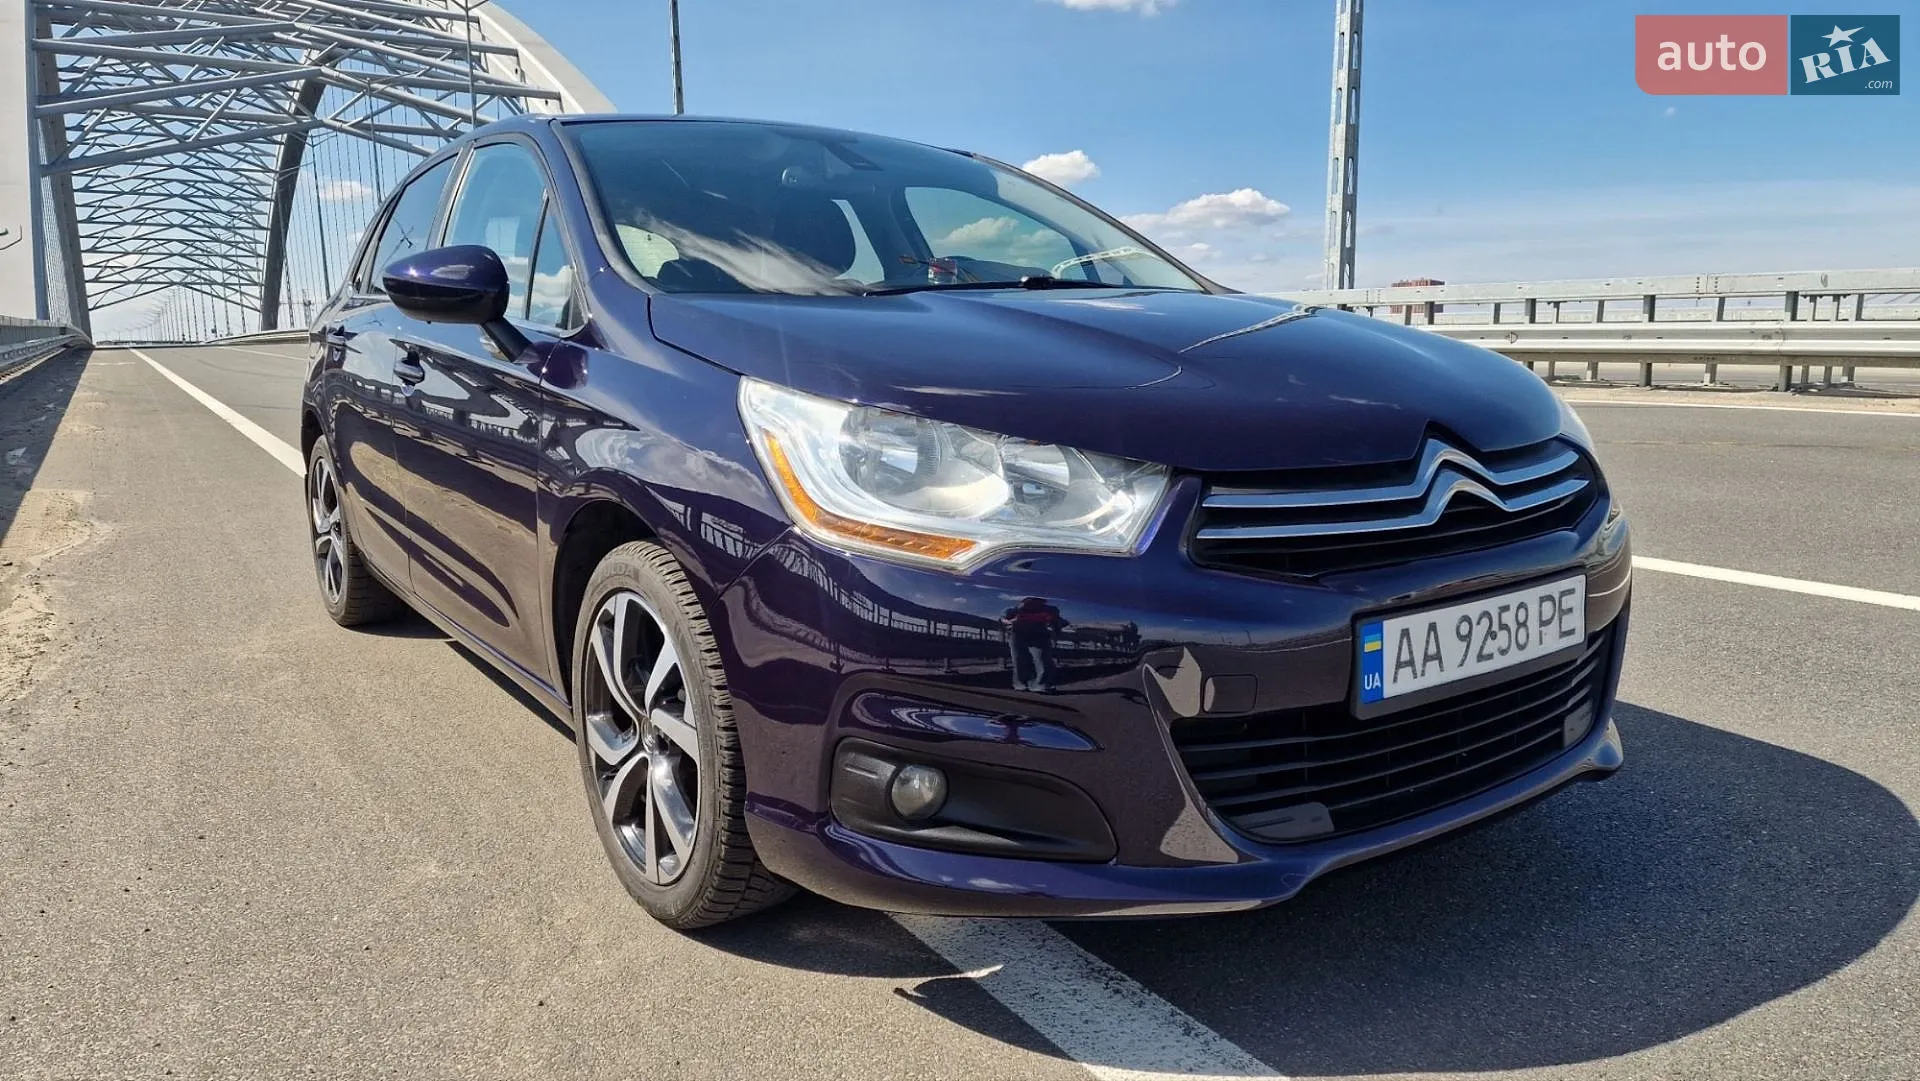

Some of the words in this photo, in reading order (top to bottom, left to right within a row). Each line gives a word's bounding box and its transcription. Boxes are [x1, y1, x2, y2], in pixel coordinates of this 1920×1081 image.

[1392, 622, 1444, 684] AA
[1456, 602, 1529, 667] 9258
[1538, 588, 1576, 645] PE
[1364, 673, 1382, 690] UA
